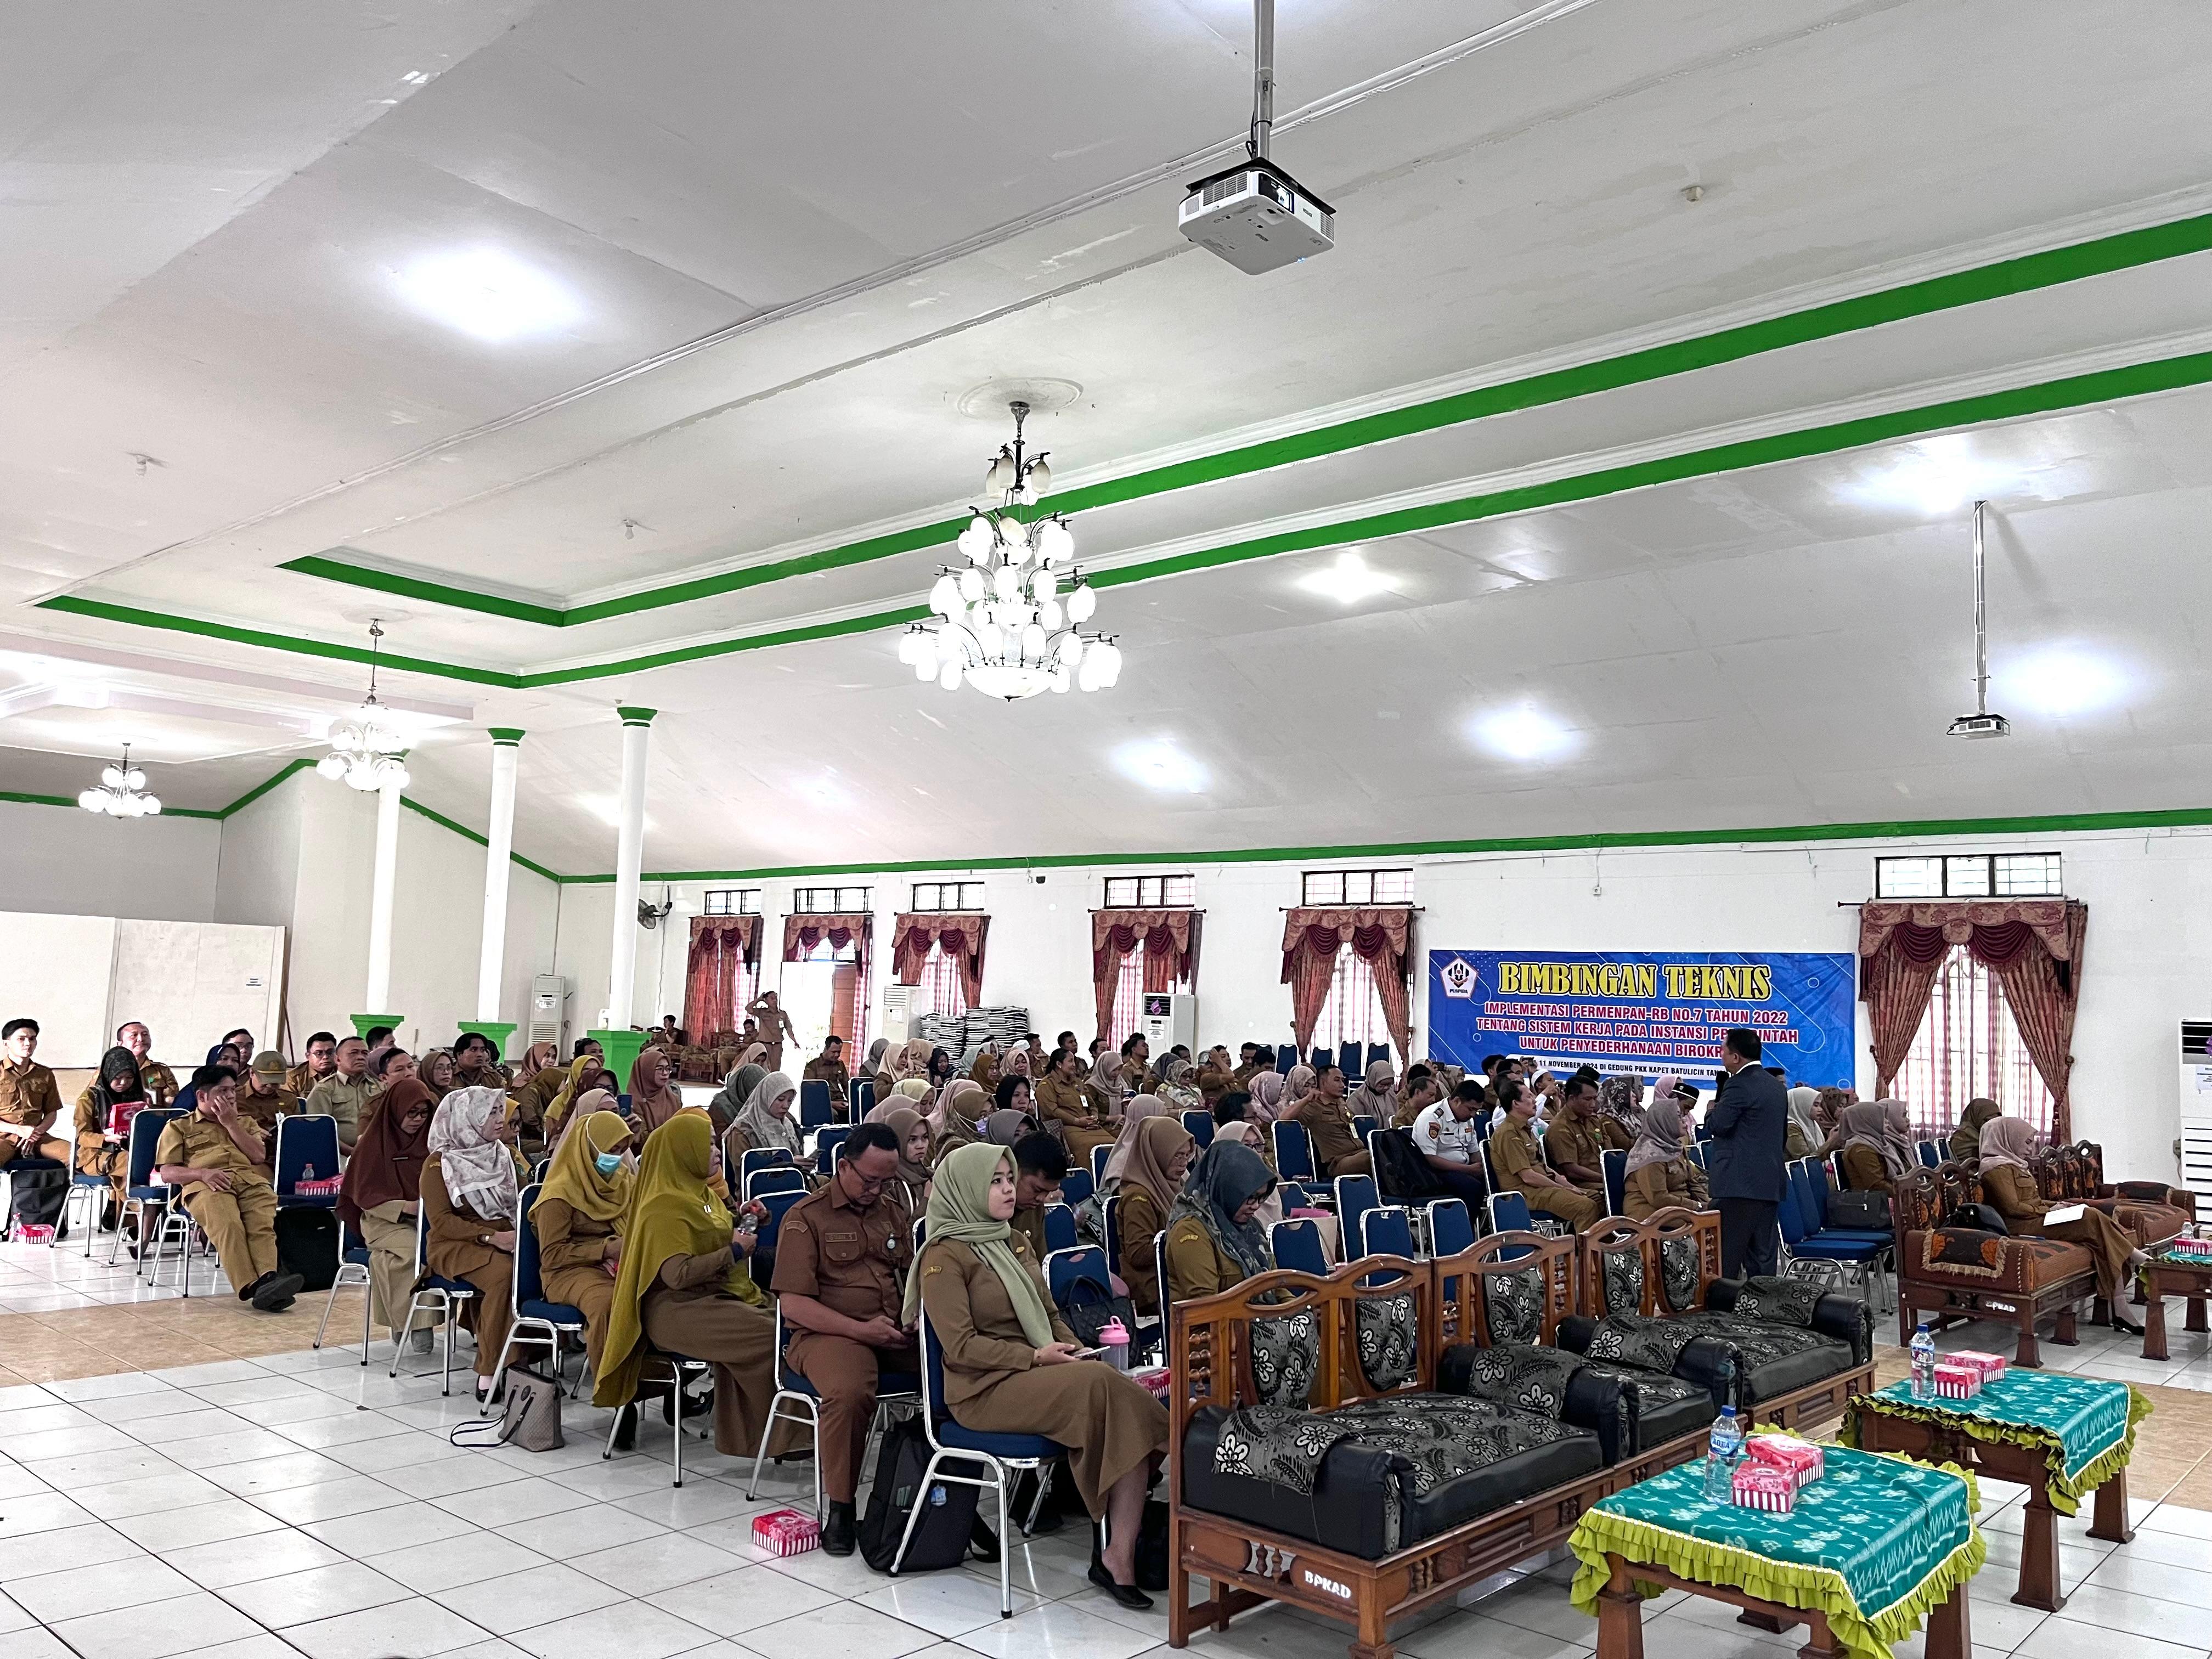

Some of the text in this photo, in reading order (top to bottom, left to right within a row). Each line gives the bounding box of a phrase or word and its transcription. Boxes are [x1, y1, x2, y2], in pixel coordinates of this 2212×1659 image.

[1499, 962, 1770, 1000] BIMBINGAN TEKNIS
[1485, 1002, 1787, 1024] IMPLEMENTASI PERMENPAN-RB NO.7 TAHUN 2022
[1477, 1018, 1798, 1043] TENTANG SISTEM KERJA PADA INSTANSI PEINTAH
[1520, 1036, 1722, 1058] UNTUK PENYEDERHANAAN BIROKR
[1548, 1060, 1581, 1069] NOVEMBER
[1671, 1067, 1705, 1075] BATULICIN
[1305, 1570, 1351, 1599] BPKAD
